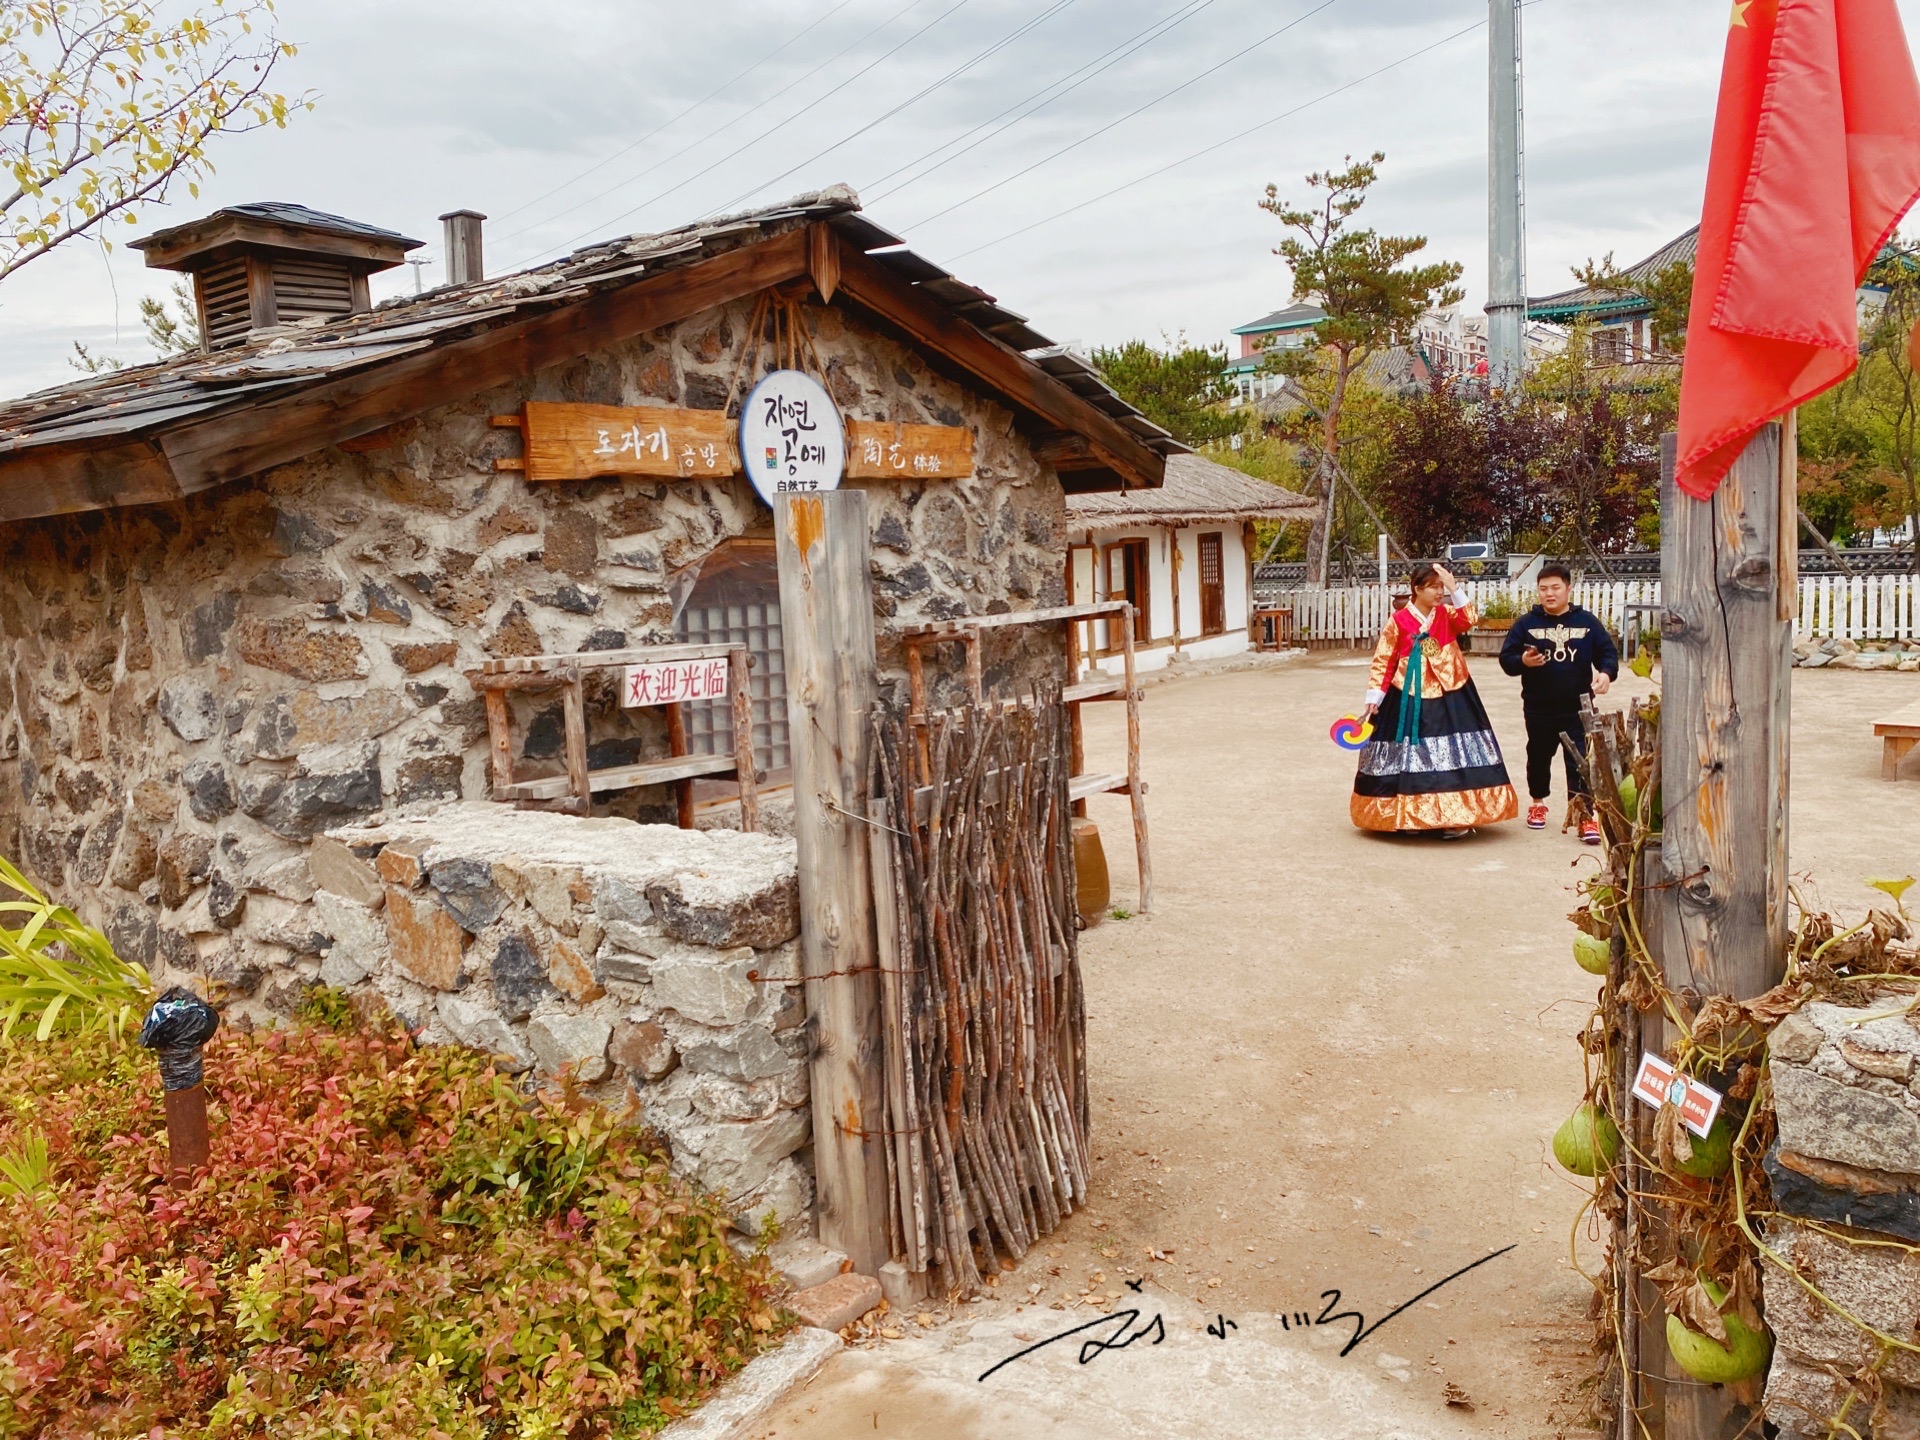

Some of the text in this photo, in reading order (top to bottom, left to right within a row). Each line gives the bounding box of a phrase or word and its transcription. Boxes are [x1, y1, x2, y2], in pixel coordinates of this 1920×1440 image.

[764, 394, 817, 431] 자연
[593, 425, 719, 468] 도자기 공방
[782, 428, 825, 475] 공예
[1544, 646, 1577, 662] BOY
[629, 661, 725, 705] 欢迎光临
